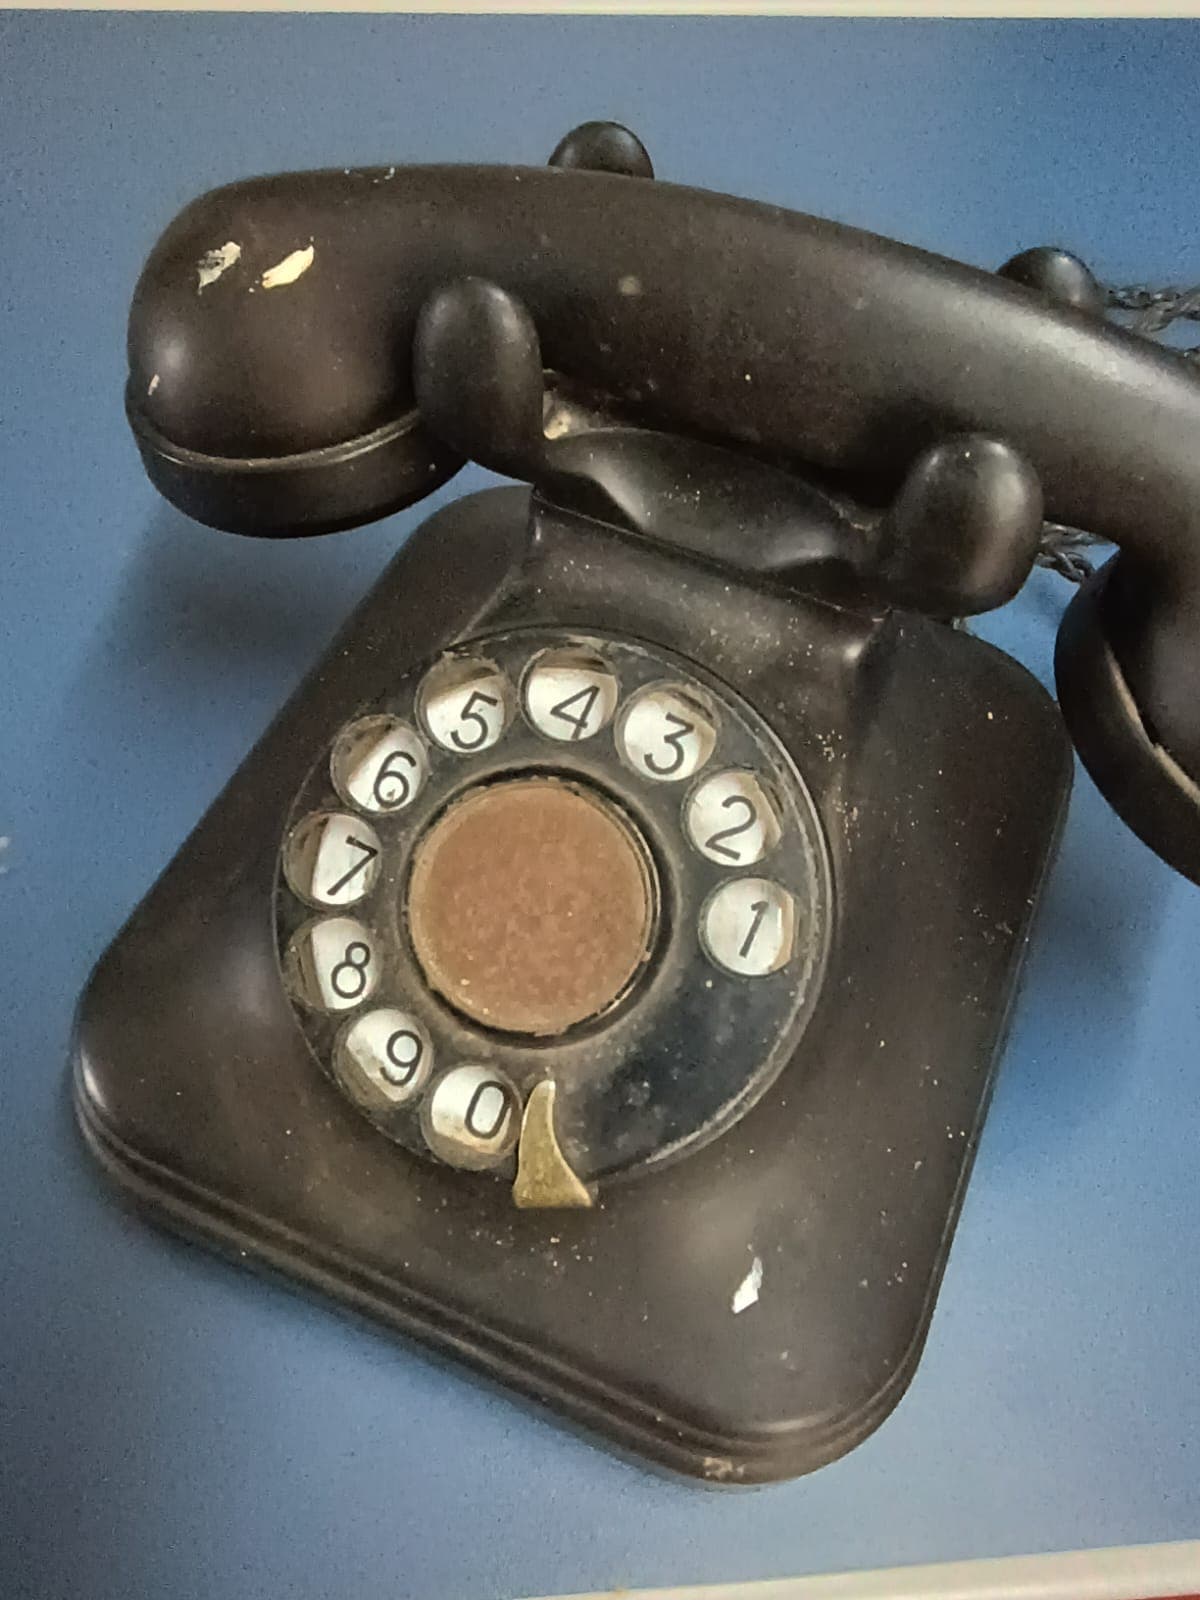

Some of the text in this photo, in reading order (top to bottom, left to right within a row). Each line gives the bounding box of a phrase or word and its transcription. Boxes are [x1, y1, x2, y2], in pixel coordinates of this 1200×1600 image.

[451, 691, 498, 750] 5
[550, 685, 600, 740] 4
[644, 712, 695, 774] 3
[373, 751, 416, 809] 6
[705, 795, 757, 861] 2
[327, 836, 378, 896] 7
[739, 900, 769, 959] 1
[331, 942, 370, 999] 8
[379, 1030, 422, 1086] 9
[464, 1080, 511, 1139] 0
